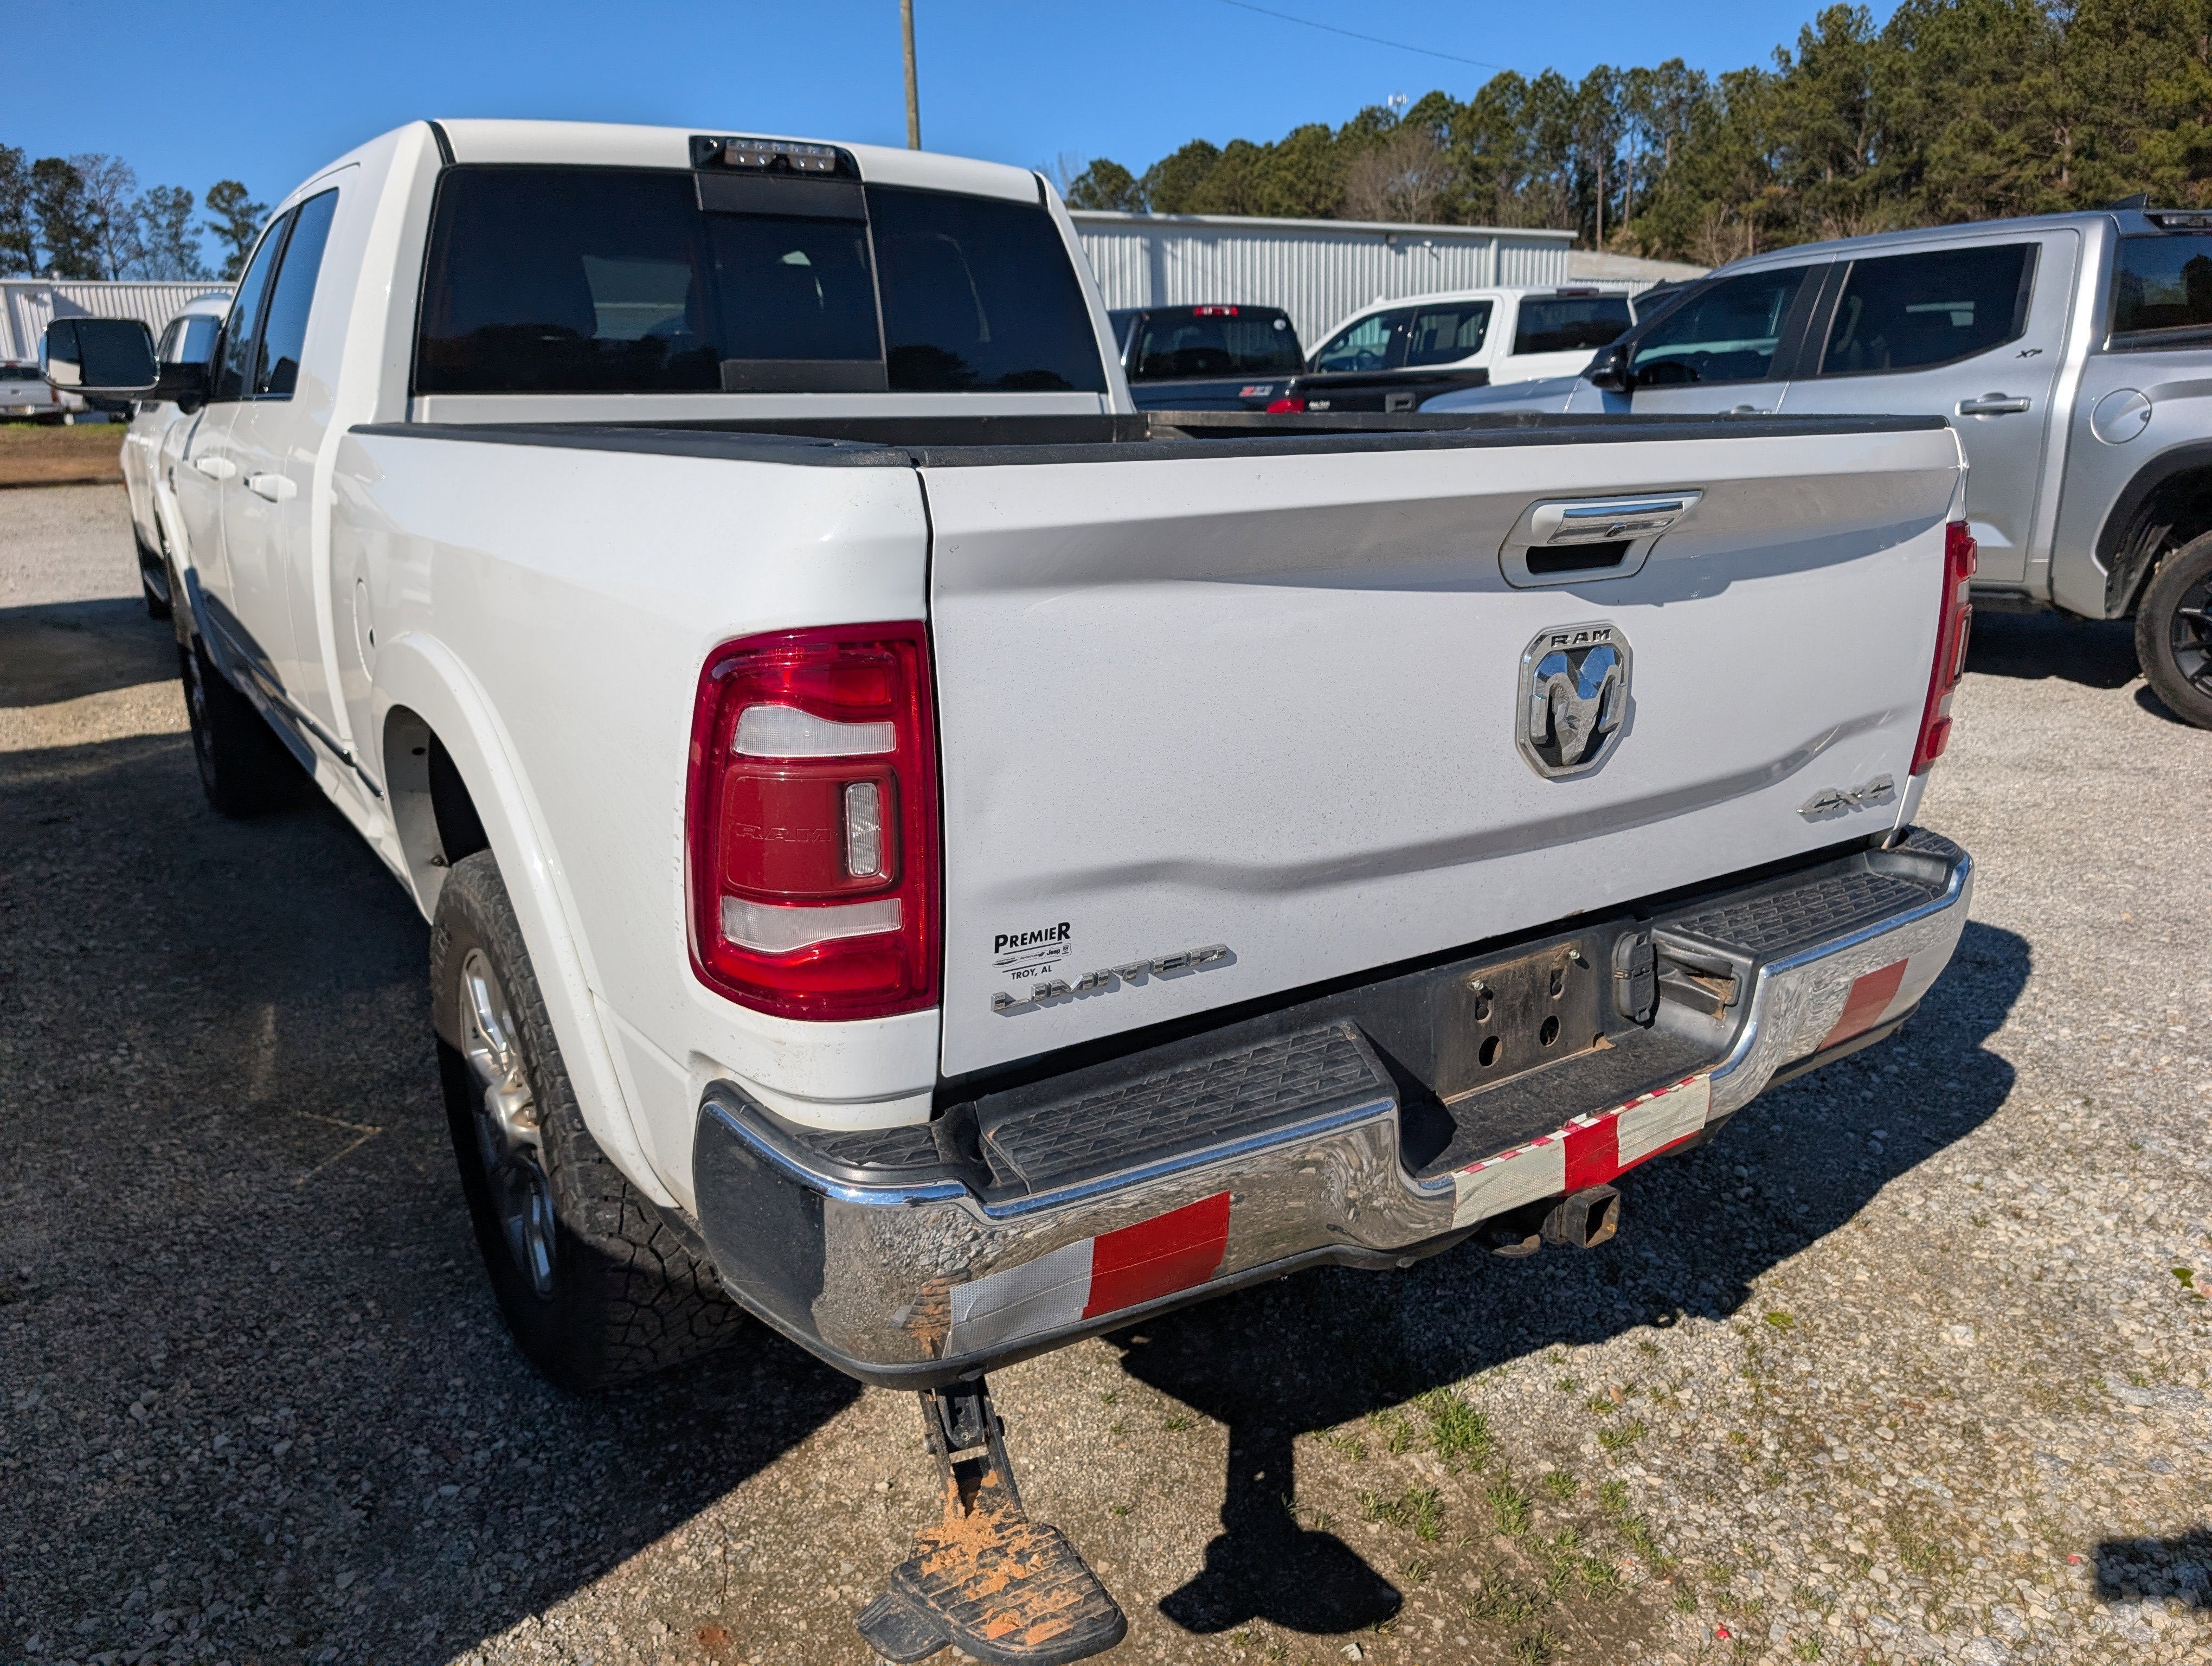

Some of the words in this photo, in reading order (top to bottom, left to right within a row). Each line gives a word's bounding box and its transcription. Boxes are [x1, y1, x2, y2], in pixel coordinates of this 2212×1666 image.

[1551, 628, 1612, 648] RAM
[735, 822, 832, 842] RAM
[994, 921, 1071, 954] PREMIER
[990, 943, 1228, 1013] LIMITED
[1011, 967, 1038, 981] TROY,
[1041, 964, 1052, 974] AL
